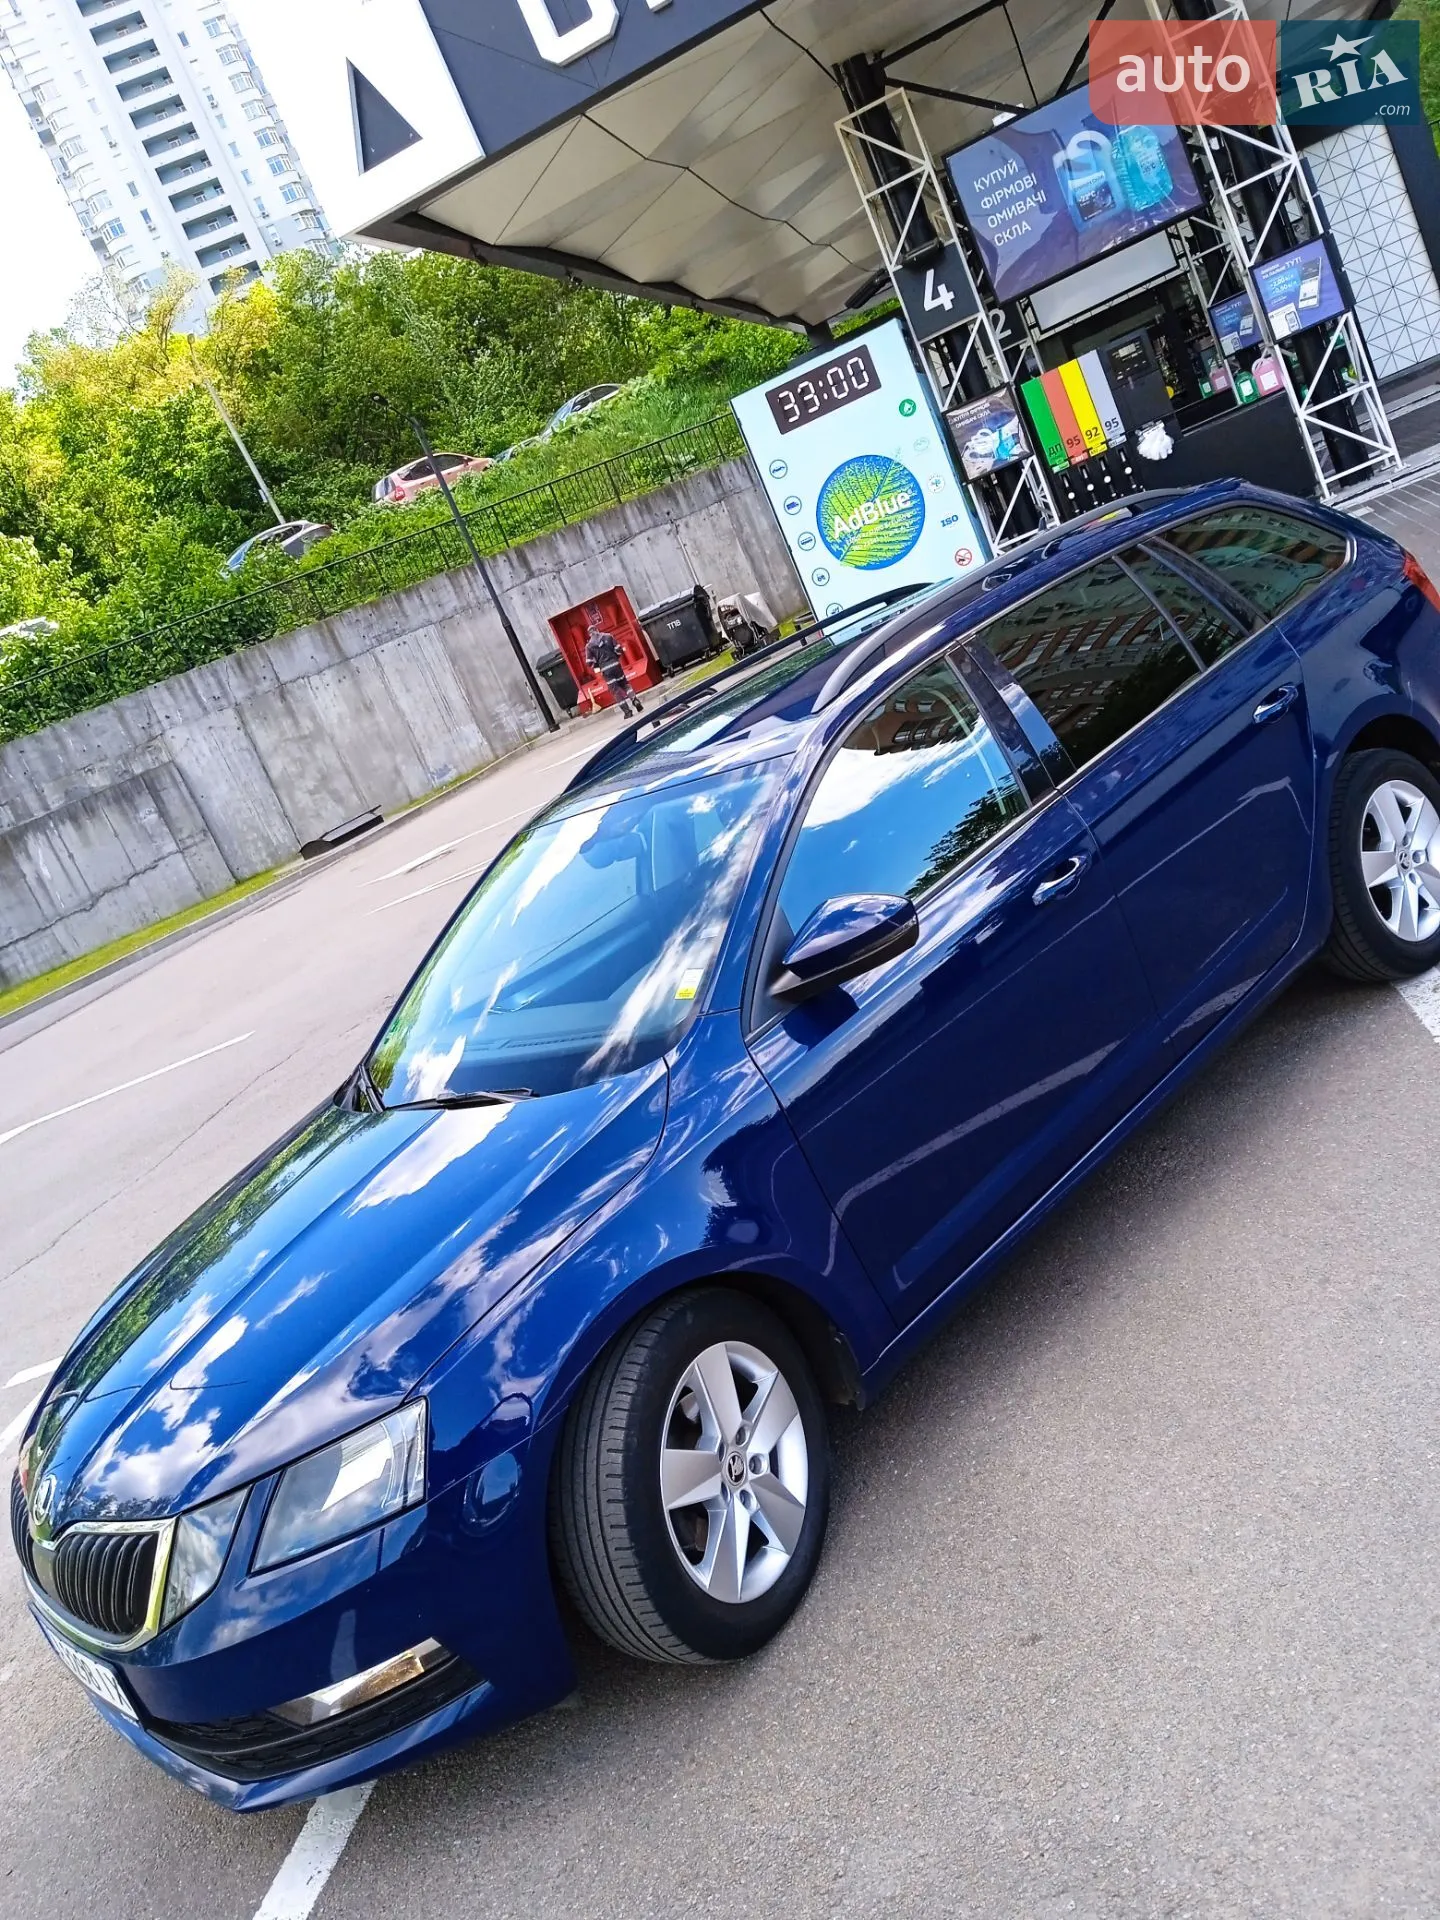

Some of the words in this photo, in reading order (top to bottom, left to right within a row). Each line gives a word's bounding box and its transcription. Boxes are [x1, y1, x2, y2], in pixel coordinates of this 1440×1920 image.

[973, 158, 1019, 193] КУПУЙ
[980, 173, 1037, 210] ФІРМОВІ
[987, 190, 1047, 229] ОМИВАЧІ
[994, 222, 1032, 248] СКЛА
[923, 268, 955, 312] 4
[988, 308, 1012, 340] 2
[777, 356, 870, 424] 33:00
[1085, 426, 1100, 439] 92
[1104, 417, 1119, 431] 95
[1066, 435, 1081, 448] 95
[940, 514, 959, 528] ISO
